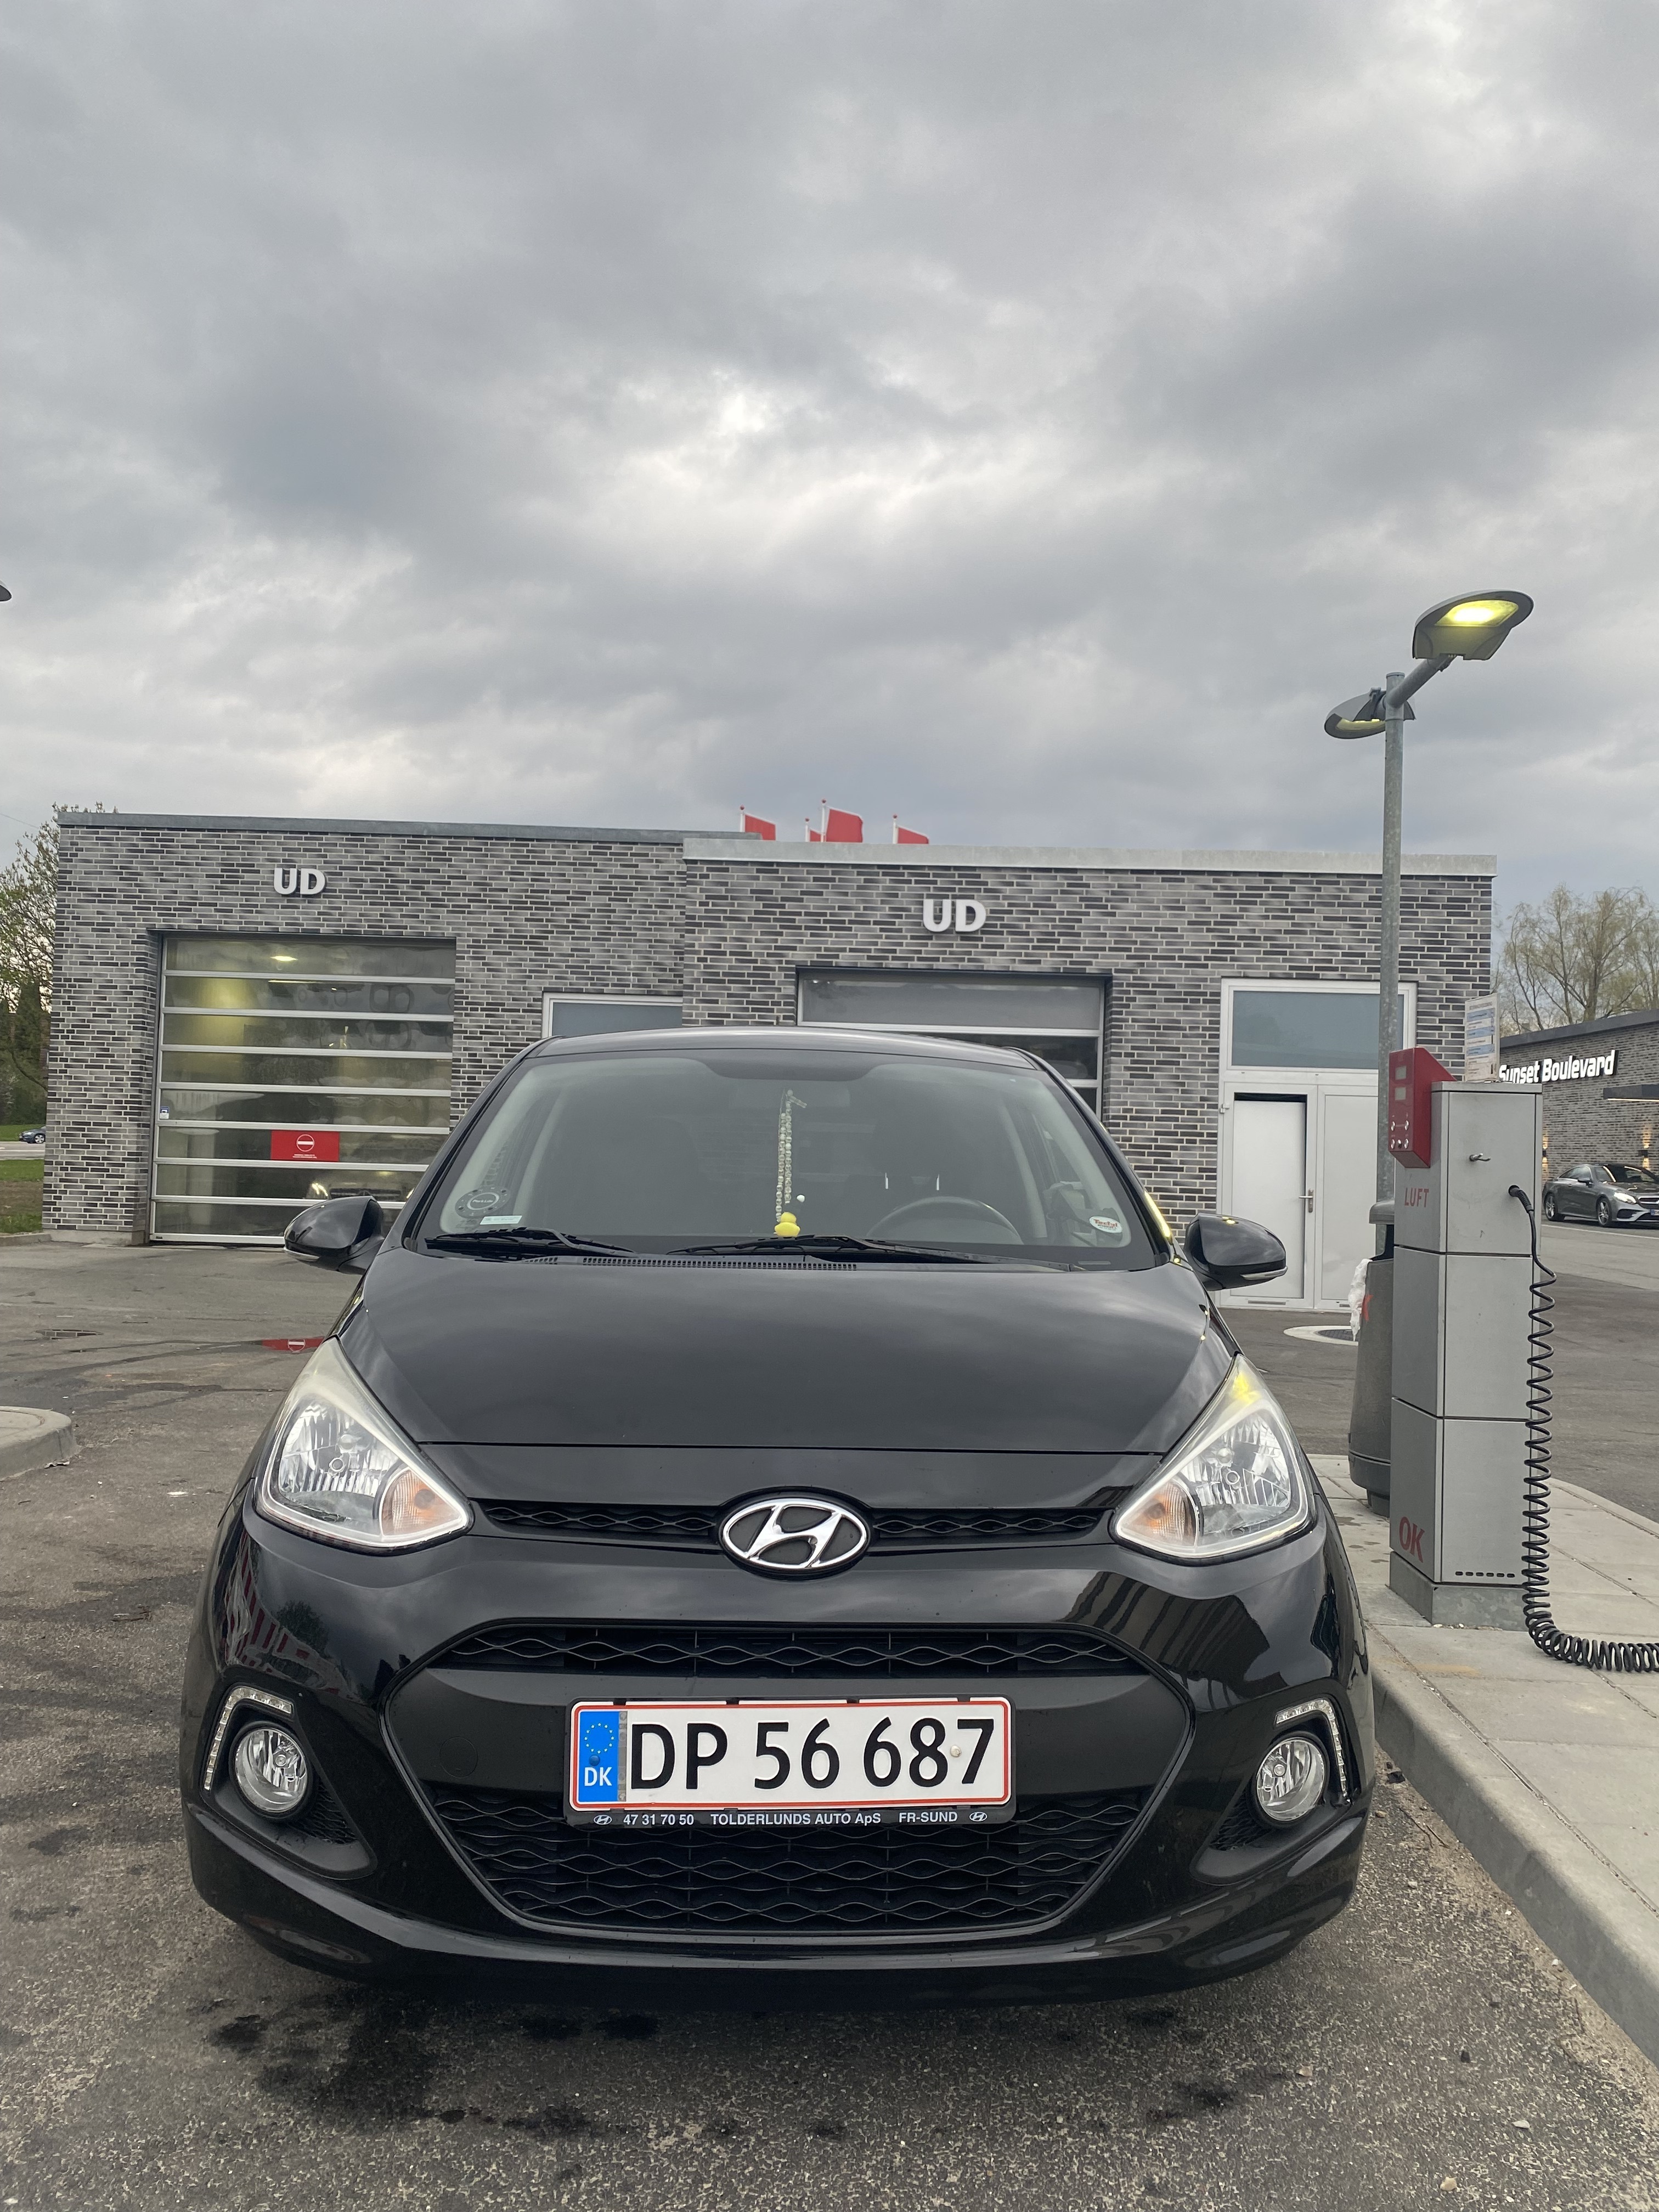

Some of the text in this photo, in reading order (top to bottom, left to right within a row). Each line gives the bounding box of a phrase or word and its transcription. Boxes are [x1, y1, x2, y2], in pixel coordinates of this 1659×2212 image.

[274, 868, 326, 895] UD
[923, 899, 986, 932] UD
[1499, 1049, 1616, 1084] Sunset Boulevard
[1404, 1187, 1429, 1207] LUFT
[1399, 1516, 1425, 1563] OK
[631, 1717, 995, 1790] DP 56 687
[584, 1767, 612, 1786] DK
[623, 1812, 958, 1826] 47 31 70 50 TOLDERLUNDS AUTO ApS FR-SUND
